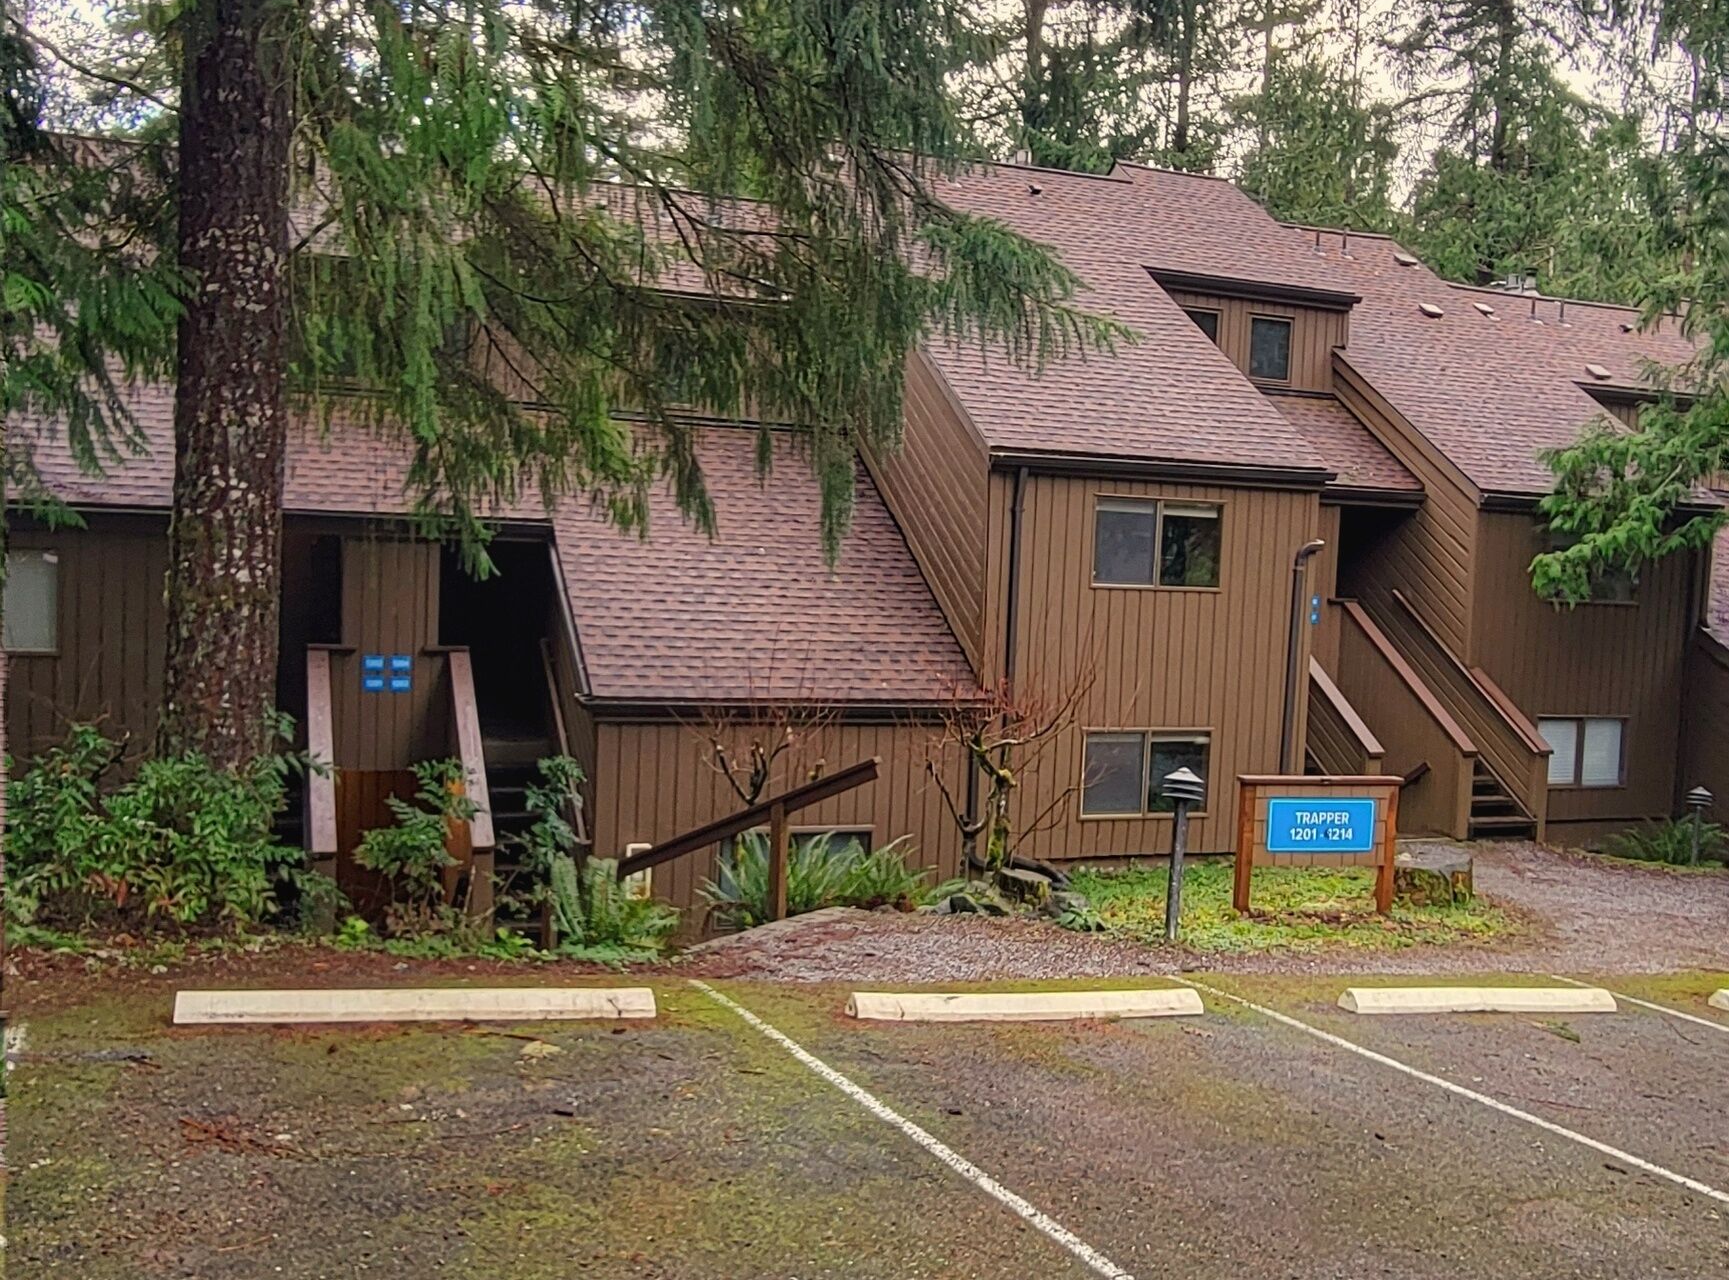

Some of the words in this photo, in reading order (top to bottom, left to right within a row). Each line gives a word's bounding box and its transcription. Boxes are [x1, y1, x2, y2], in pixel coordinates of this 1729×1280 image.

[1295, 811, 1349, 825] TRAPPER
[1289, 827, 1317, 840] 1201
[1326, 827, 1353, 840] 1214
